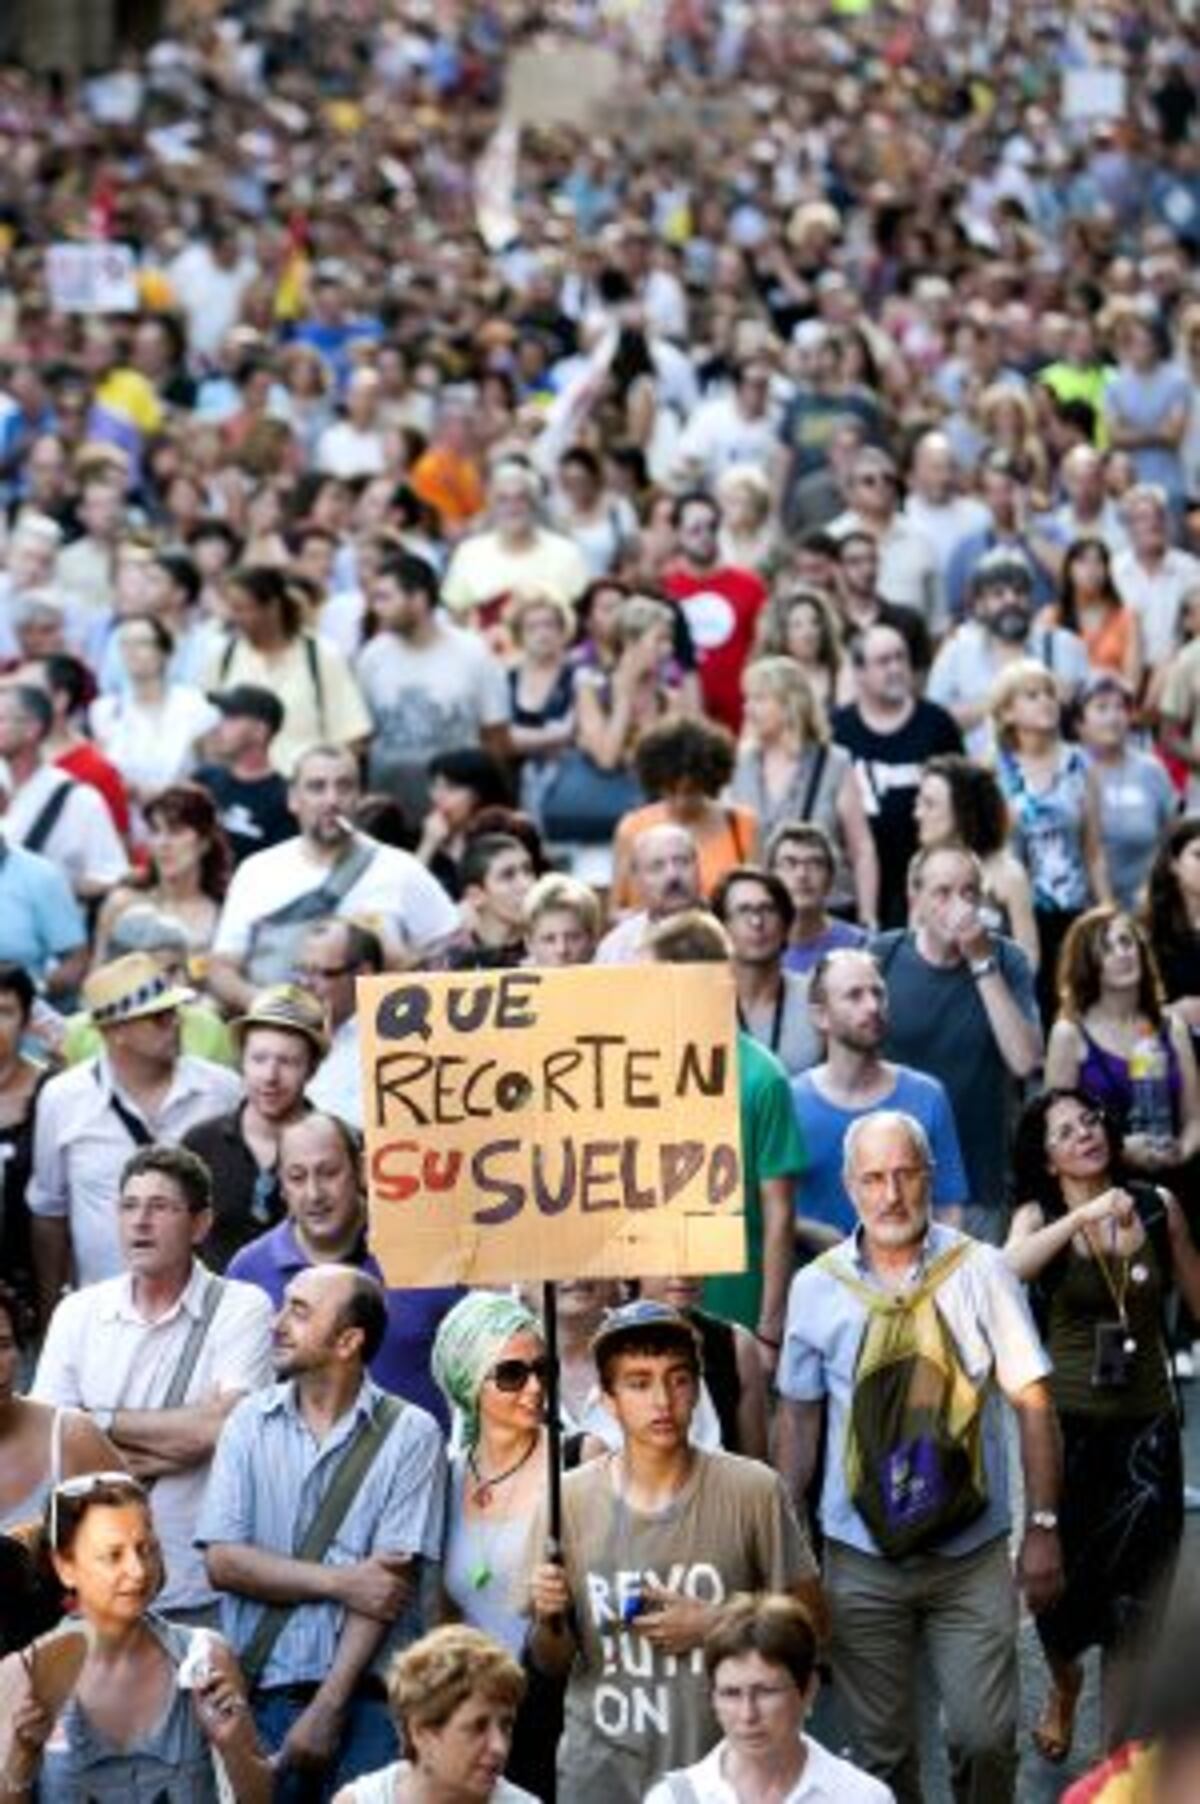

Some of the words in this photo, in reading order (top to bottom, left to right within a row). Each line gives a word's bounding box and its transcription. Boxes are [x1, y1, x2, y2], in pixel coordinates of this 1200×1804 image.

[375, 975, 541, 1041] QUE
[375, 1036, 726, 1127] RECORTEN
[372, 1140, 463, 1202] SU
[471, 1136, 740, 1225] SUELDO
[595, 1684, 669, 1737] ON
